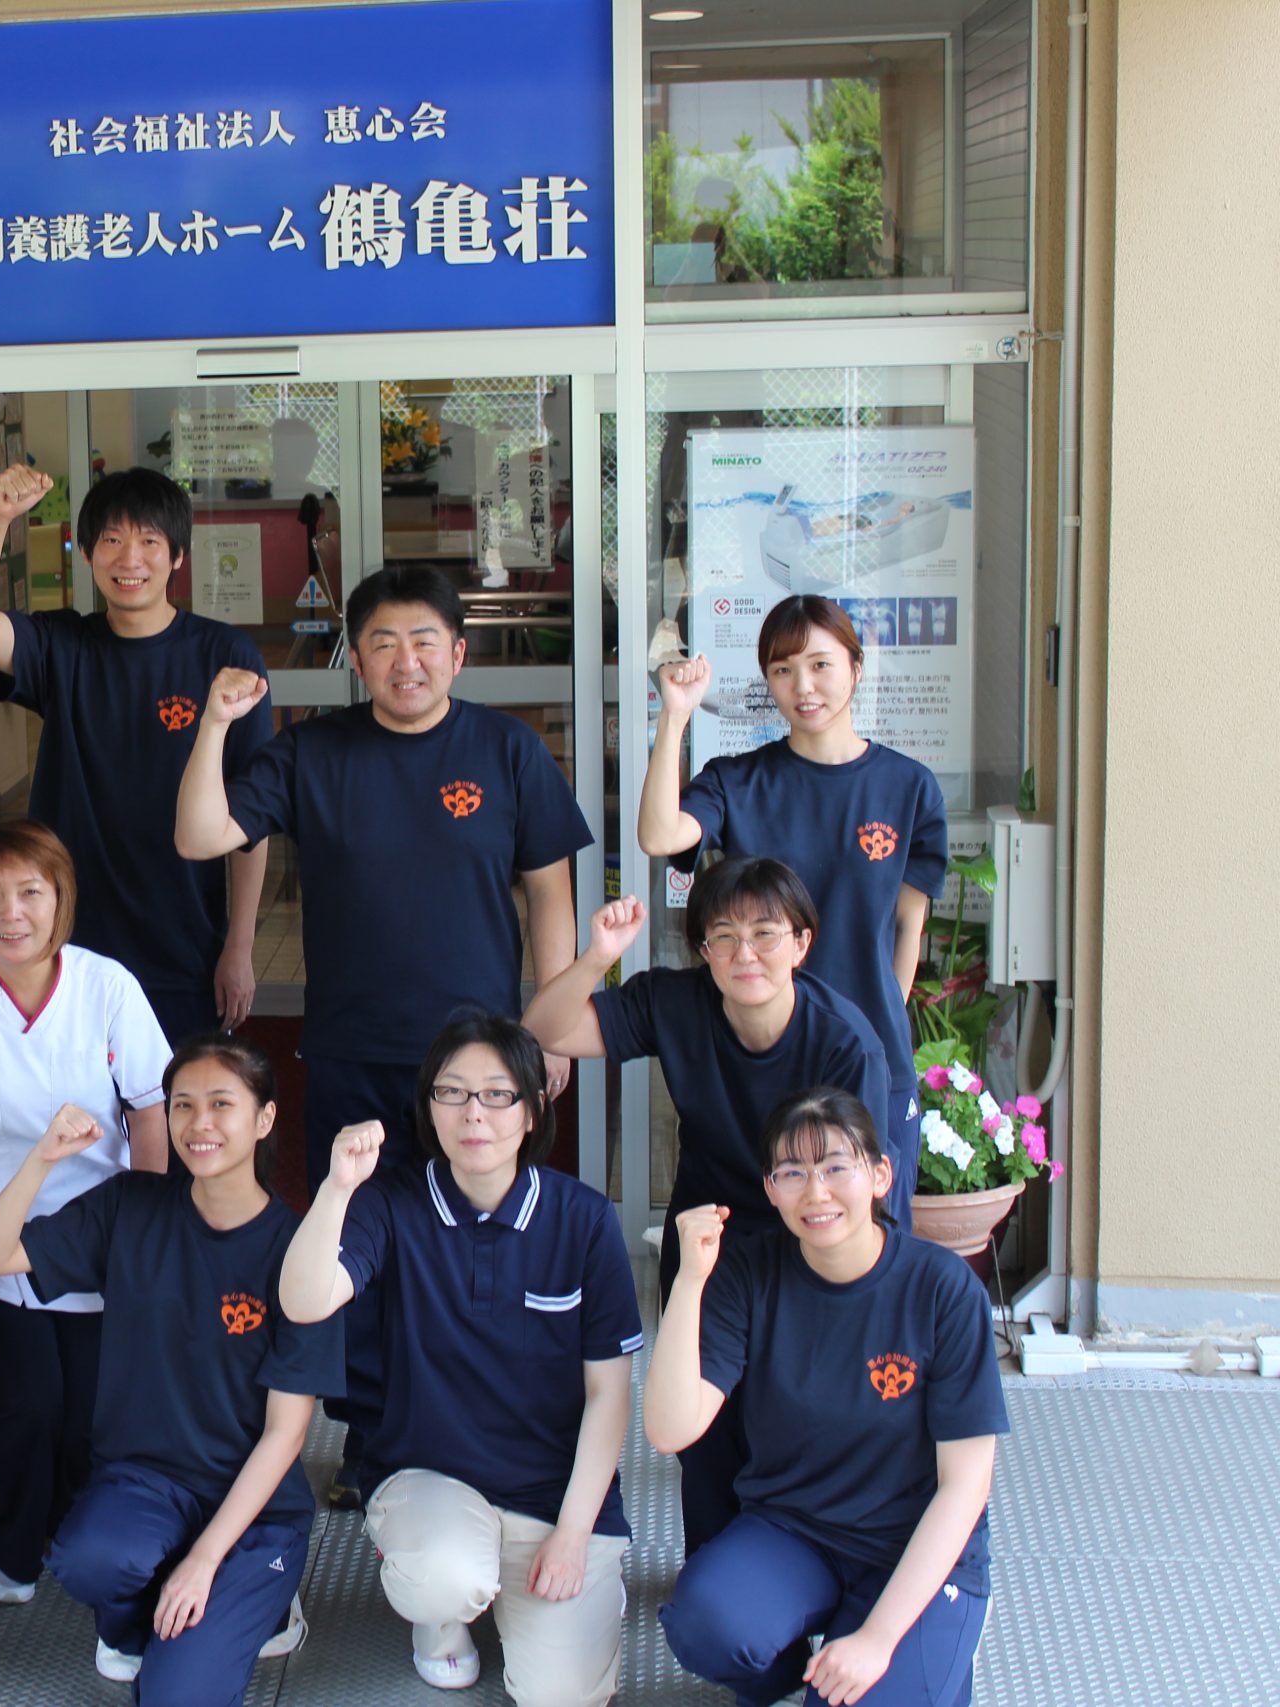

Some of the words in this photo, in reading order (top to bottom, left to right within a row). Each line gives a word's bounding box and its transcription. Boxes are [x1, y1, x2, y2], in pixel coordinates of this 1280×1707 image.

[49, 109, 296, 157] 社会福祉法人
[323, 102, 448, 145] 恵心会
[319, 175, 589, 272] 鶴亀荘
[711, 457, 762, 466] MINATO
[734, 598, 754, 606] GOOD
[734, 607, 761, 615] DESIGN
